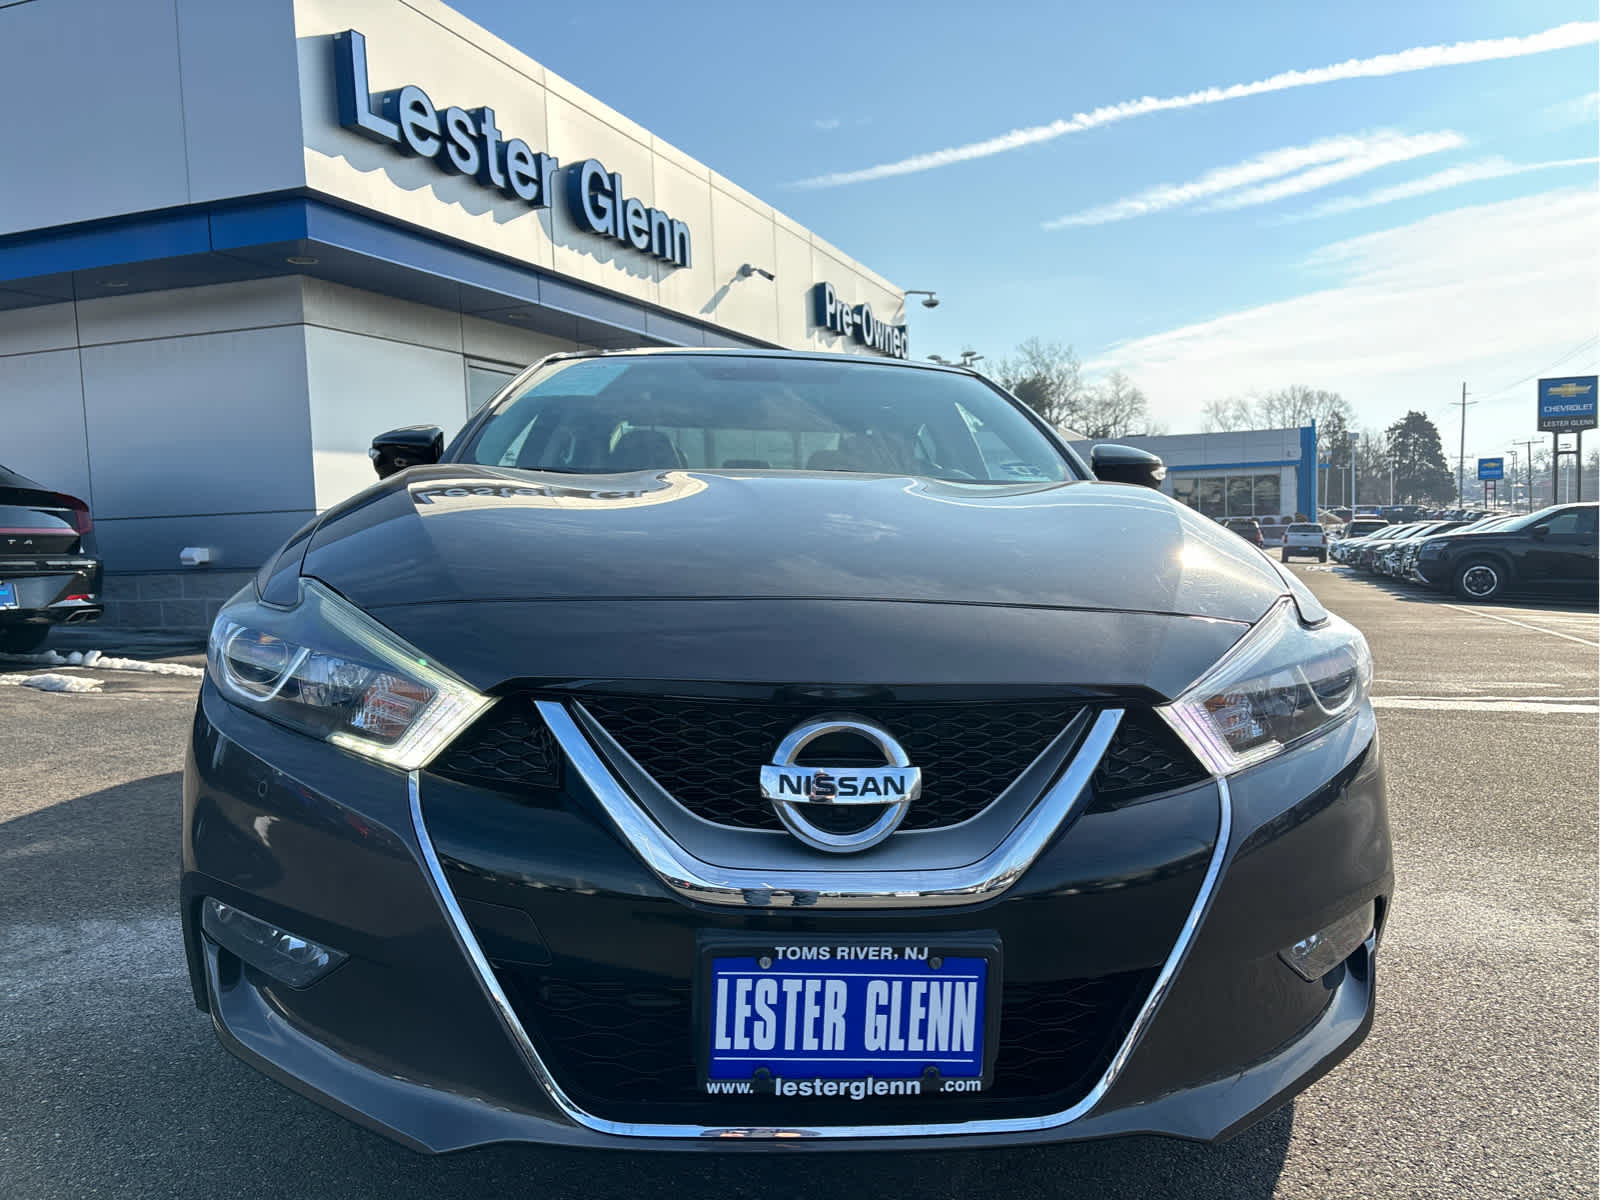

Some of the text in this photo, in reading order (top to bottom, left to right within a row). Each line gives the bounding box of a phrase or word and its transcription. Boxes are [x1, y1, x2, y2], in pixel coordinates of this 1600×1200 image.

[336, 29, 692, 269] Lester Glenn
[816, 281, 909, 360] Pre-Owned
[1544, 404, 1593, 413] CHEVROLET
[1543, 418, 1594, 428] LESTER GLENN
[778, 774, 905, 797] NISSAN
[774, 946, 929, 961] TOMS RIVER, NJ
[715, 978, 978, 1052] LESTER GLENN
[706, 1077, 982, 1100] www. lesterglenn .com
